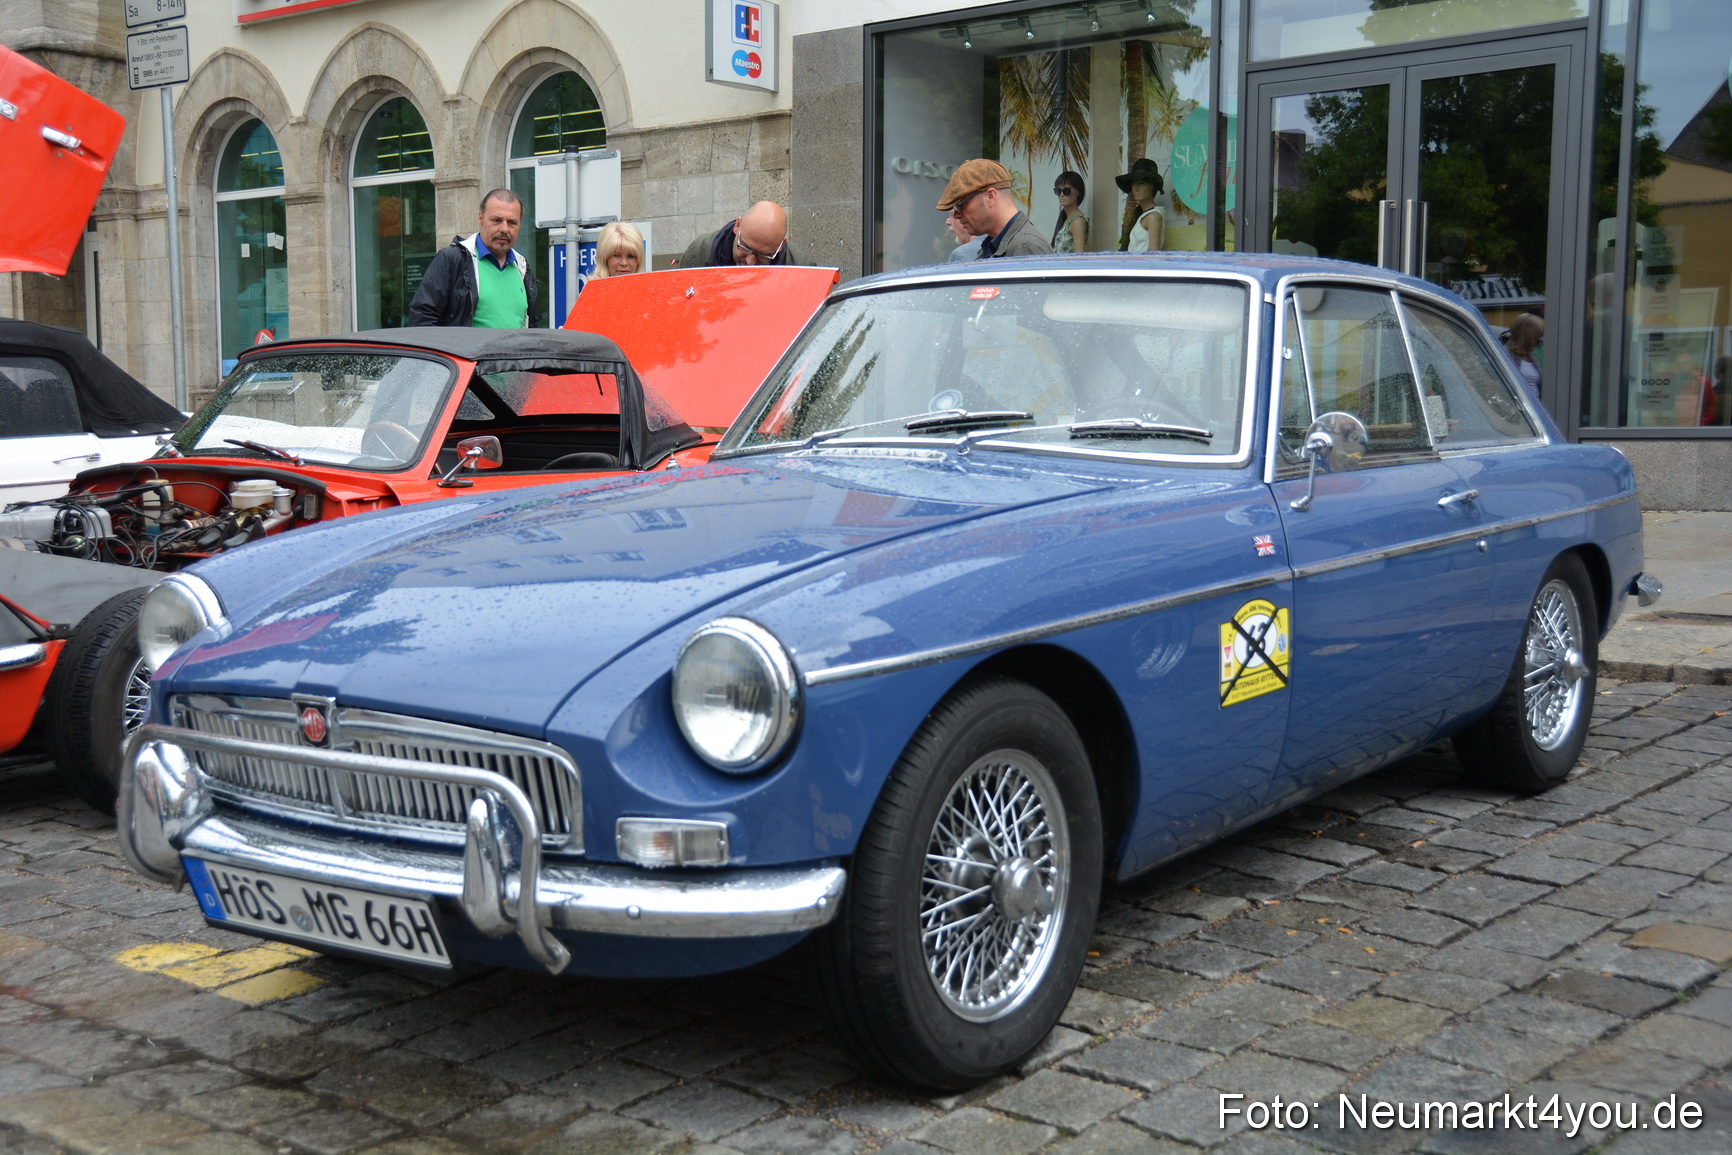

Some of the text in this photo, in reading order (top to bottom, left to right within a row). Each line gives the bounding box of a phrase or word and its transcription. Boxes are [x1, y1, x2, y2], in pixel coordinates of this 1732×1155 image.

[129, 6, 138, 17] Sa
[156, 34, 177, 43] Parkschein
[734, 58, 760, 70] Maestro
[560, 248, 597, 267] HER
[304, 712, 323, 737] MG
[206, 893, 216, 908] D
[302, 886, 362, 940] MG
[364, 899, 444, 956] 66H
